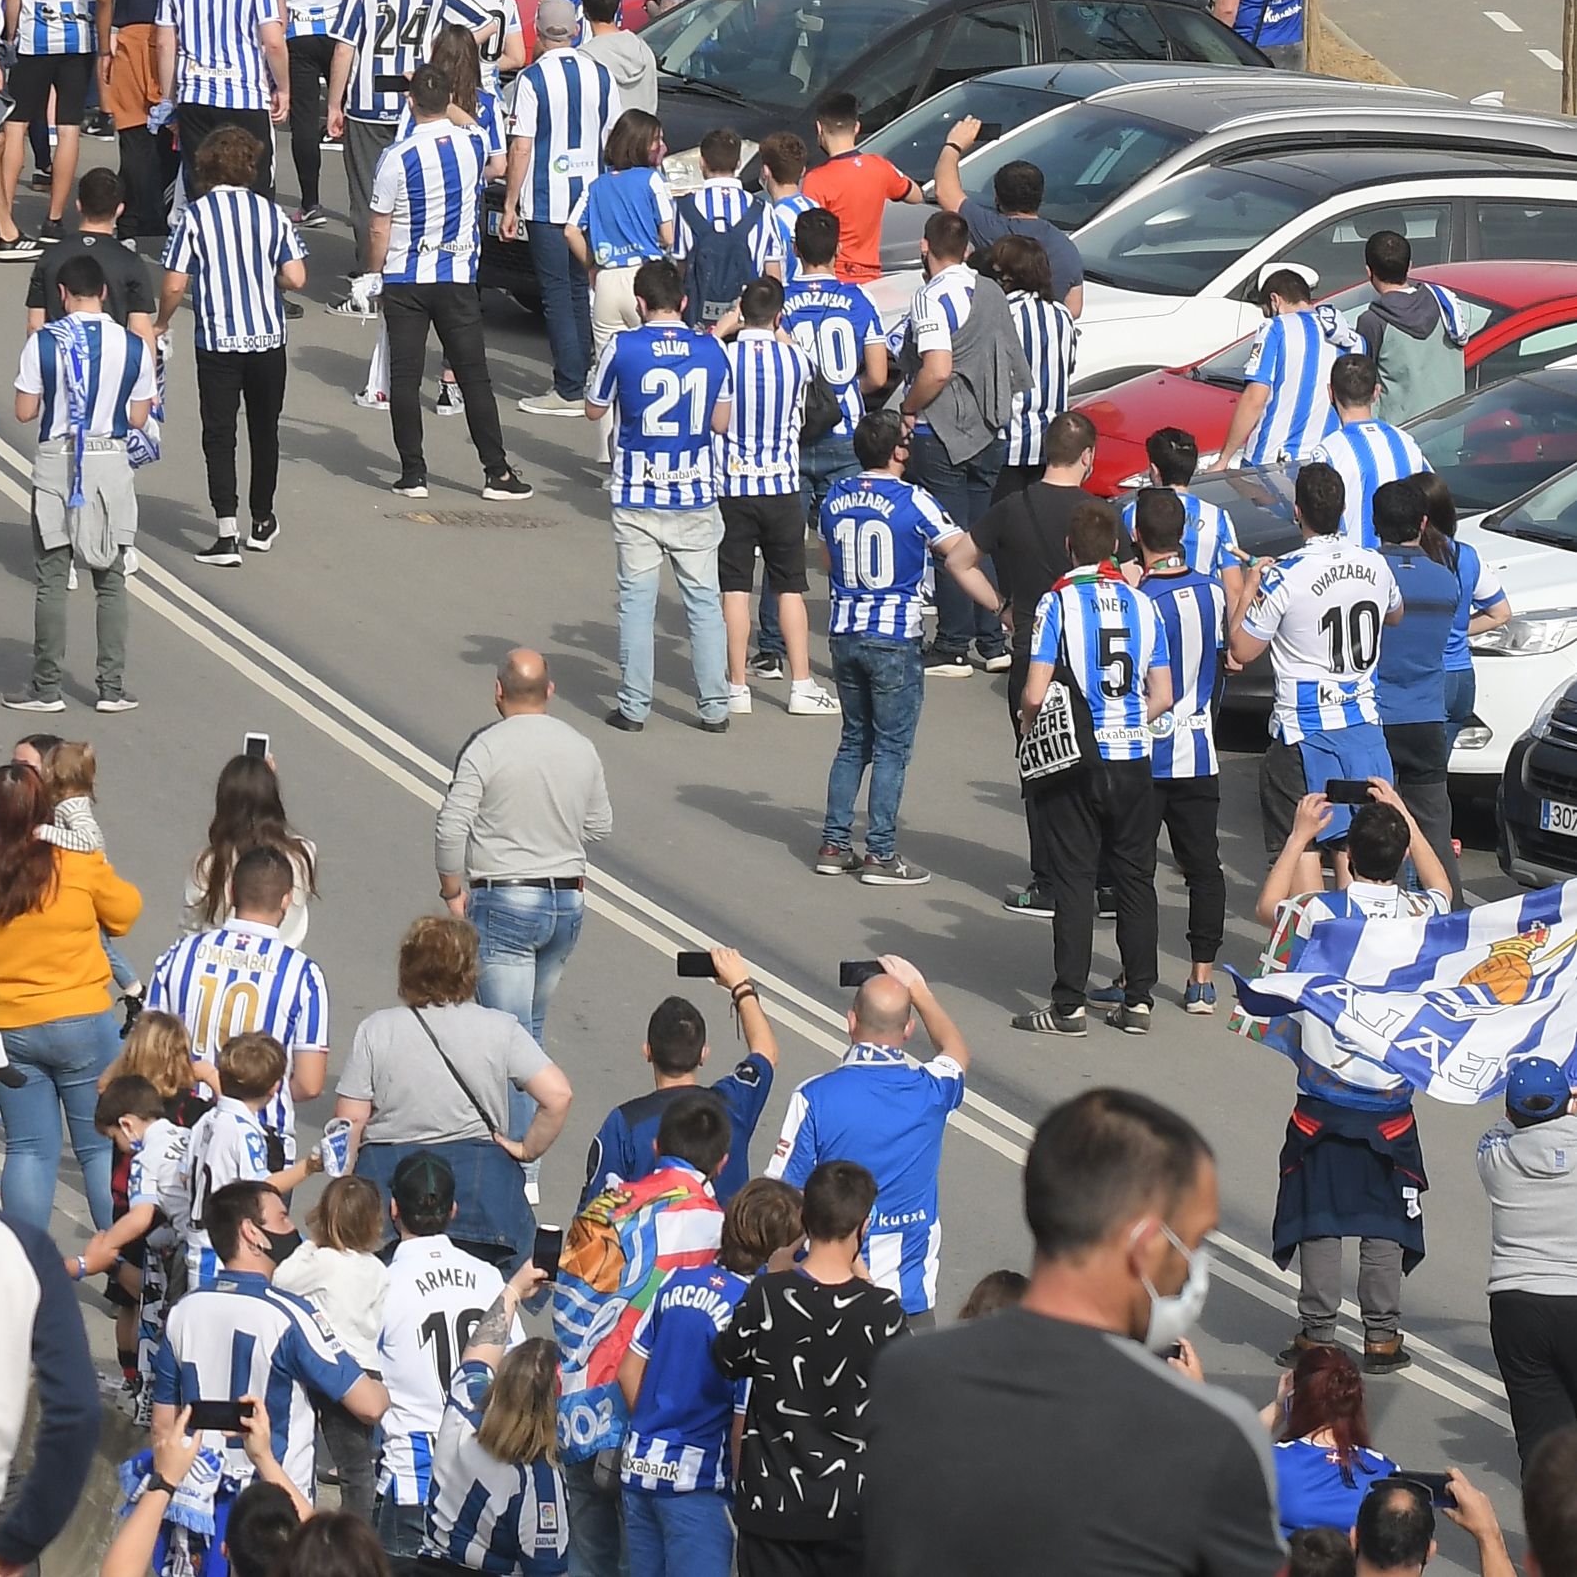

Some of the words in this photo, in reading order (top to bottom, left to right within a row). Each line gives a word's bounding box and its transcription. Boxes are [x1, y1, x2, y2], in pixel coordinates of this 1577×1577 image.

[373, 2, 433, 59] 24
[217, 337, 242, 349] REAL
[651, 339, 690, 358] SILVA
[791, 315, 858, 386] 10
[641, 366, 709, 437] 21
[642, 460, 701, 482] Kutxabank
[828, 490, 896, 520] OYARZABAL
[832, 518, 896, 591] 10
[1310, 563, 1379, 598] OYARZABAL
[1090, 598, 1129, 615] ANER
[1316, 600, 1381, 675] 10
[1096, 626, 1133, 700] 5
[196, 943, 275, 975] OYARZABAL
[195, 974, 260, 1054] 10
[878, 1208, 927, 1228] kutxa
[414, 1266, 477, 1297] ARMEN
